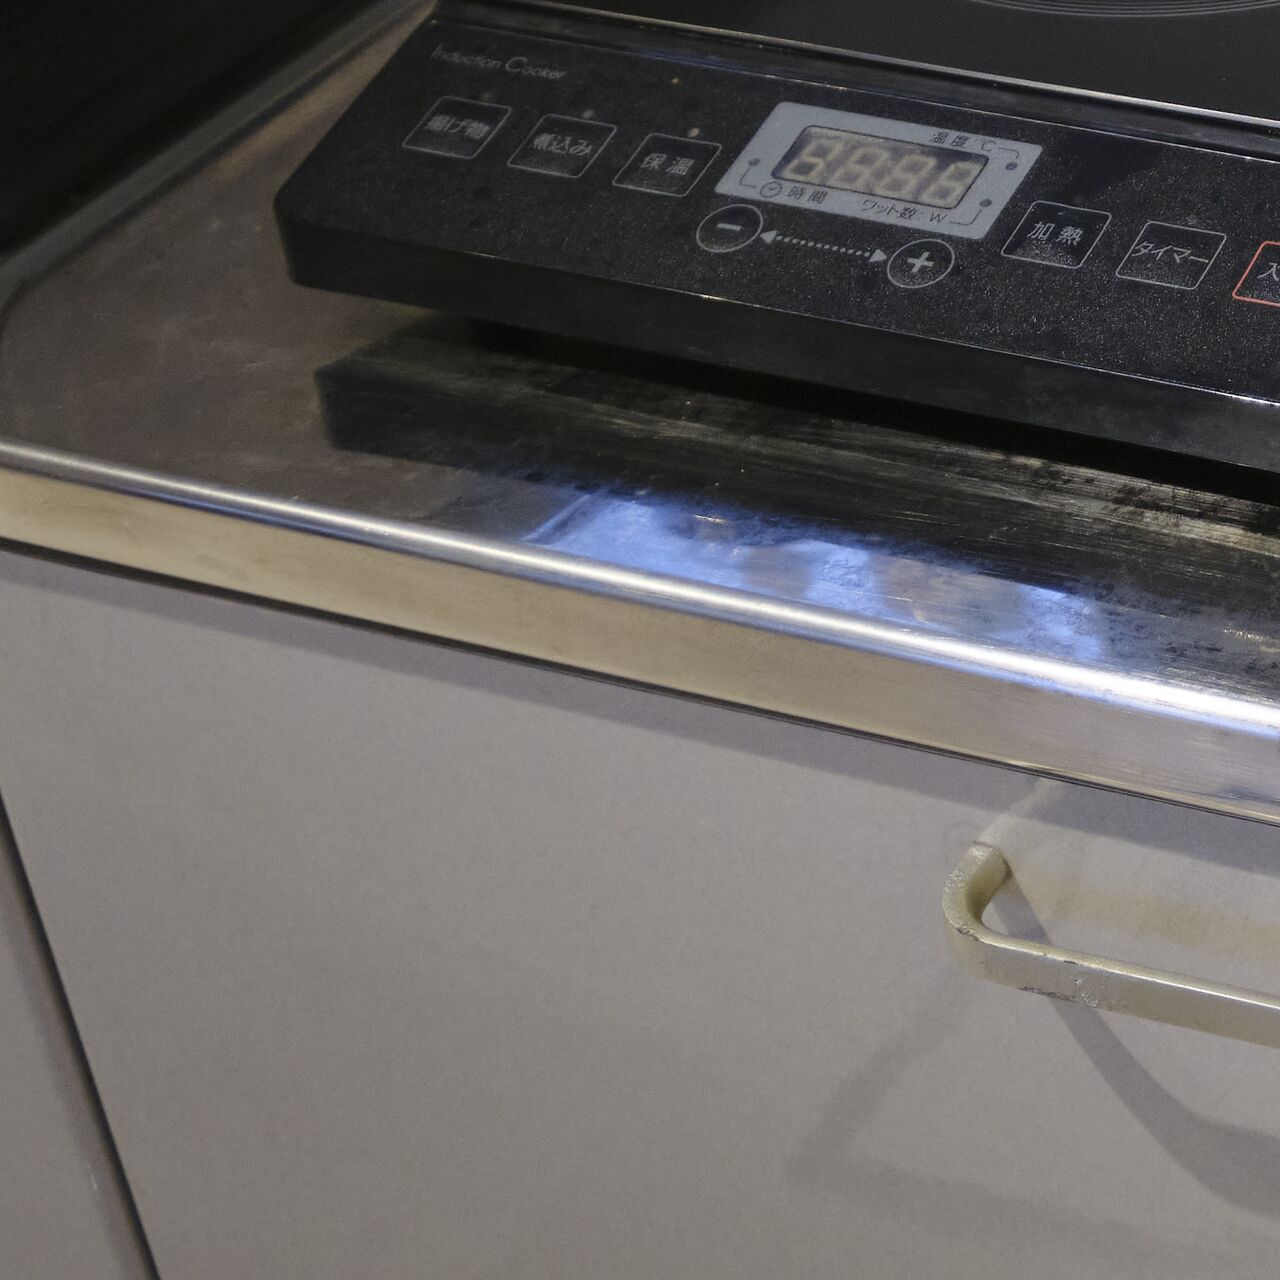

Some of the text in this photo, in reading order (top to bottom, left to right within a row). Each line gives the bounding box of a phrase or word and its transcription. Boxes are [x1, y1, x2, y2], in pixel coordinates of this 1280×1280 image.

[641, 152, 695, 176] 保温
[1026, 221, 1085, 247] 加熱
[1132, 241, 1210, 264] タイマー
